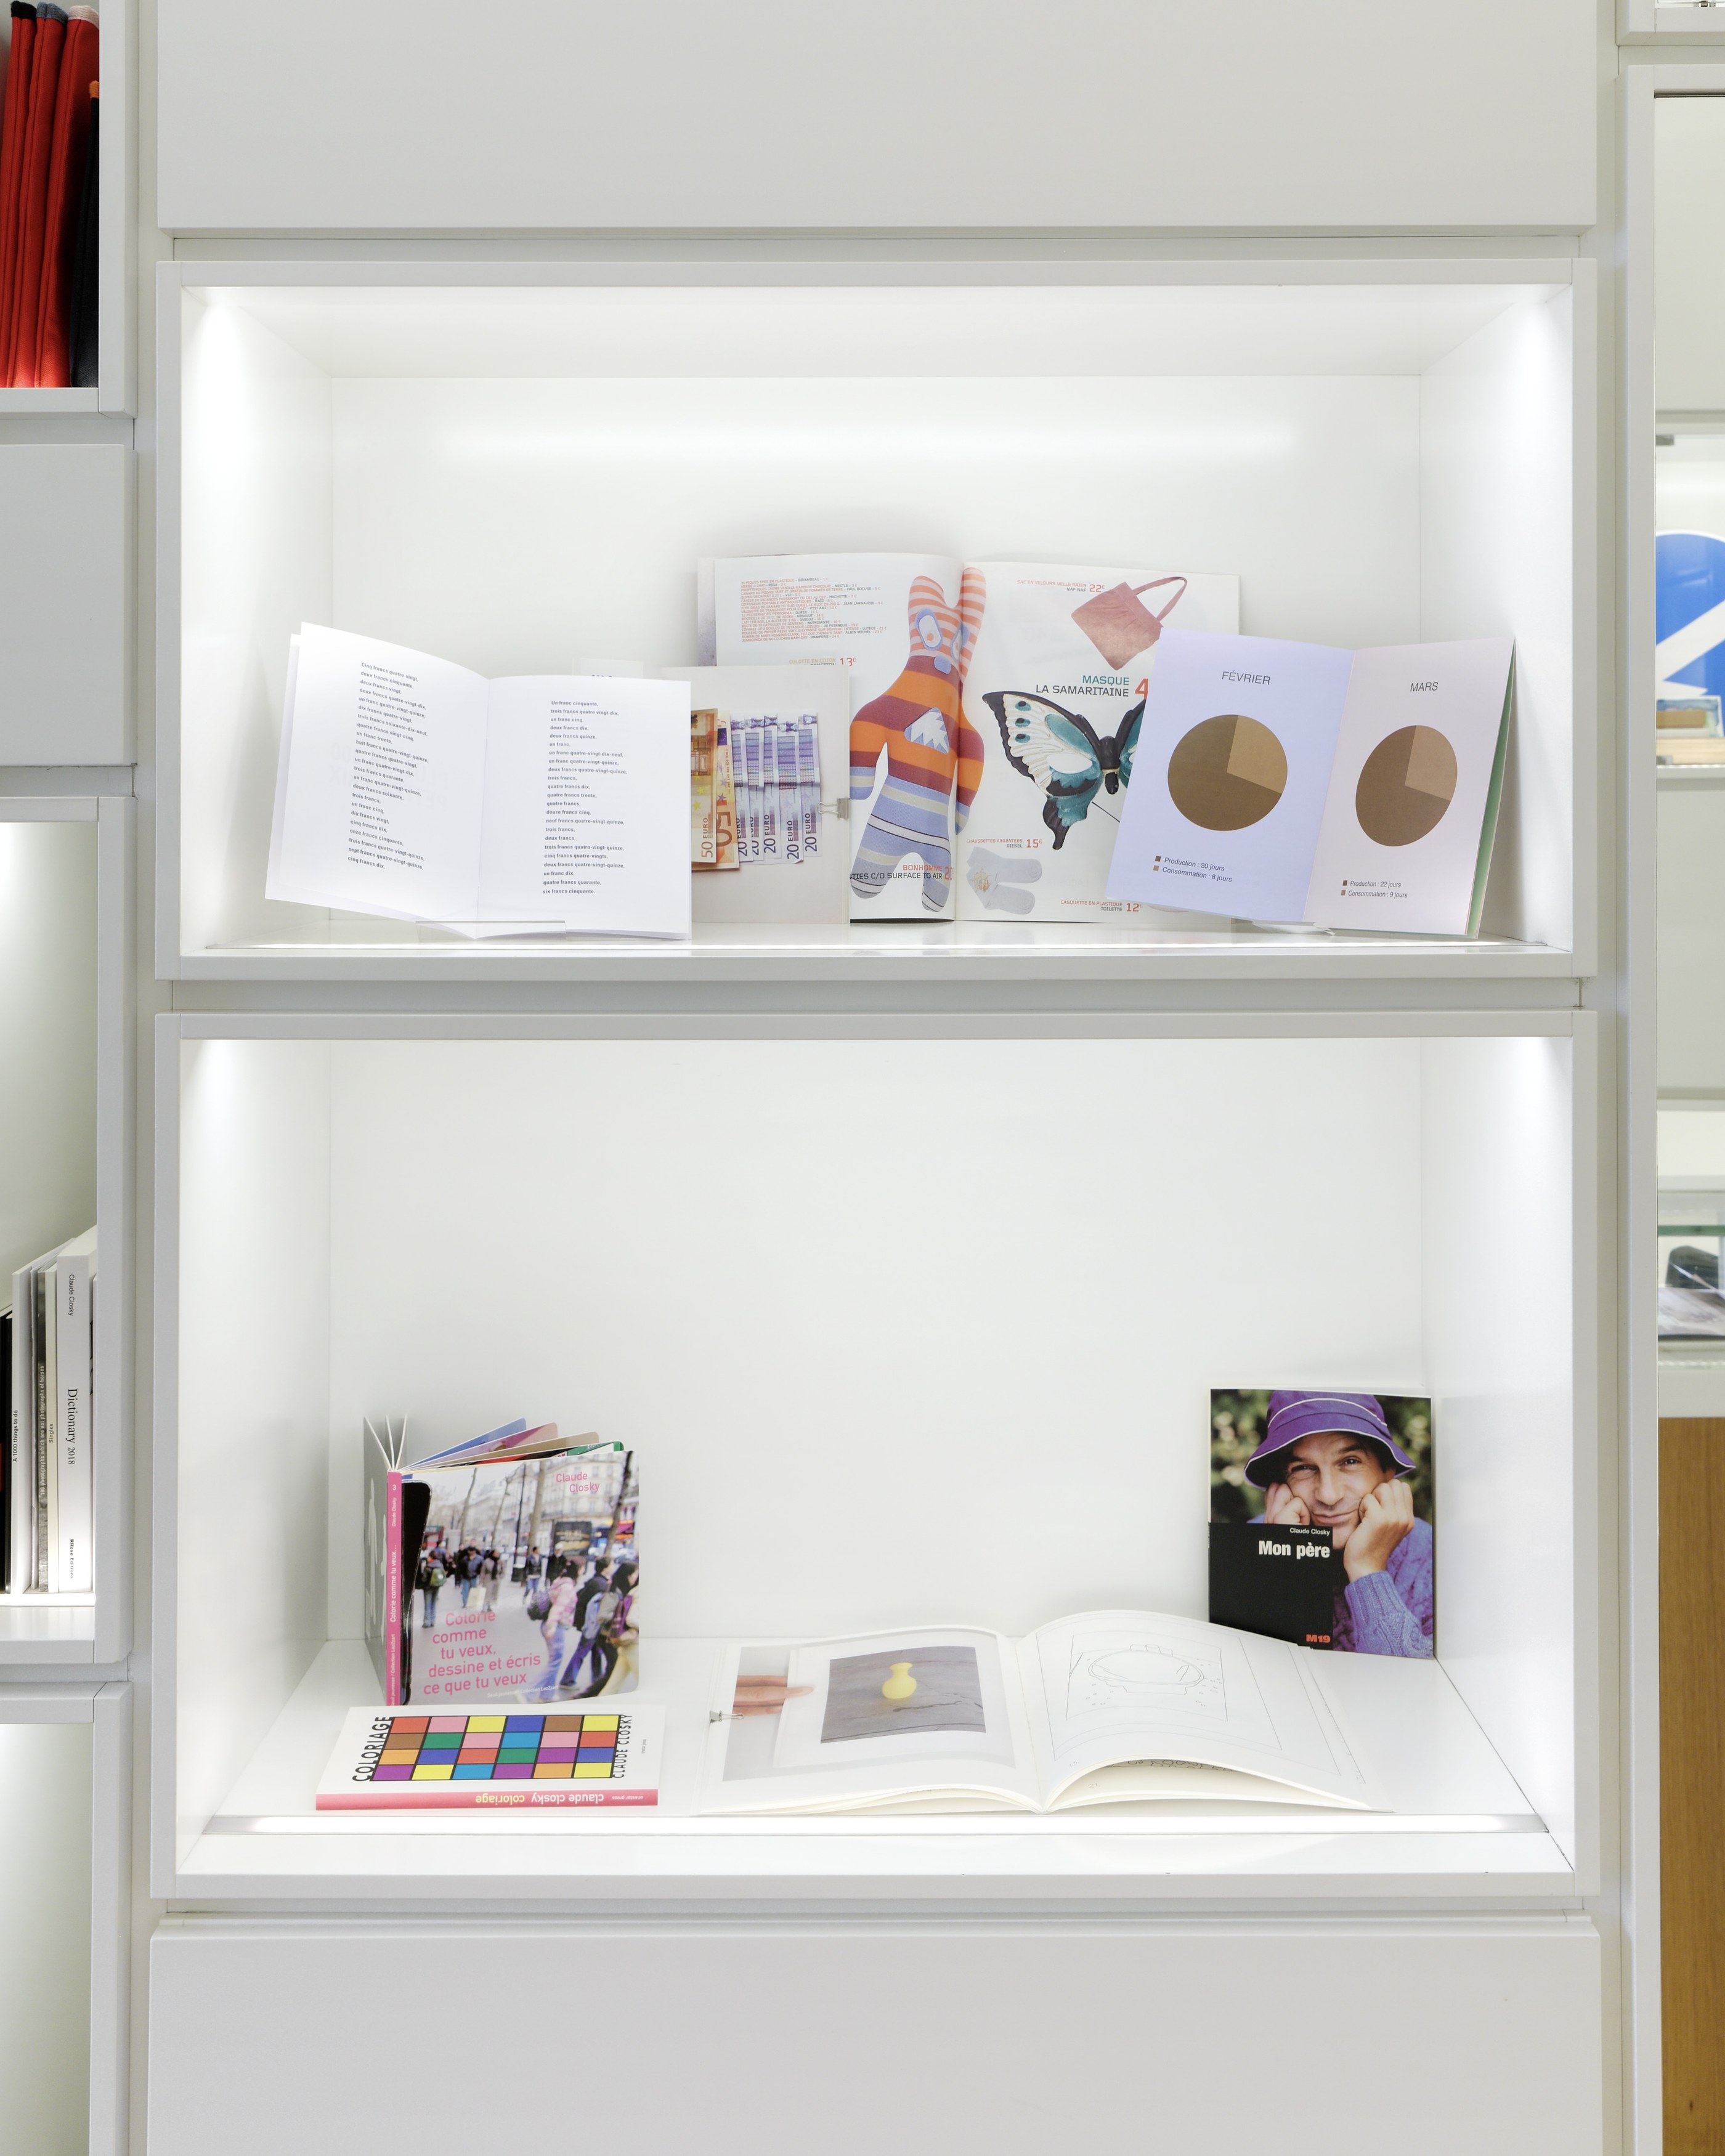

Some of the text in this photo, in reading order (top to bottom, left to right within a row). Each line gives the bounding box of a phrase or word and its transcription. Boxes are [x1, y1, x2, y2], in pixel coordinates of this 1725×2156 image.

[1082, 675, 1129, 686] MASQUE
[1222, 670, 1271, 685] FÉVRIER
[1036, 684, 1129, 697] LA SAMARITAINE
[1410, 681, 1439, 692] MARS
[701, 841, 713, 857] 50
[738, 841, 747, 856] 20
[764, 838, 776, 853] 20
[805, 837, 817, 851] 20
[787, 845, 799, 859] 20
[1164, 857, 1196, 867] Production
[1209, 864, 1225, 872] jours
[1163, 867, 1207, 878] Consommation
[65, 1389, 78, 1443] Dictionary
[556, 1472, 588, 1483] Claude
[569, 1482, 599, 1493] Closky
[1311, 1528, 1330, 1536] Closky
[1259, 1541, 1331, 1560] Mon père
[445, 1611, 495, 1626] Colorie
[432, 1628, 487, 1644] comme
[1306, 1634, 1331, 1643] M19
[440, 1644, 496, 1660] tu veux,
[429, 1653, 541, 1677] dessine et écris
[424, 1673, 527, 1695] ce que tu veux
[352, 1717, 392, 1781] COLORIAGE
[612, 1714, 632, 1778] CLAUDE CLOSKY
[476, 1792, 604, 1805] claude closky coloriage
